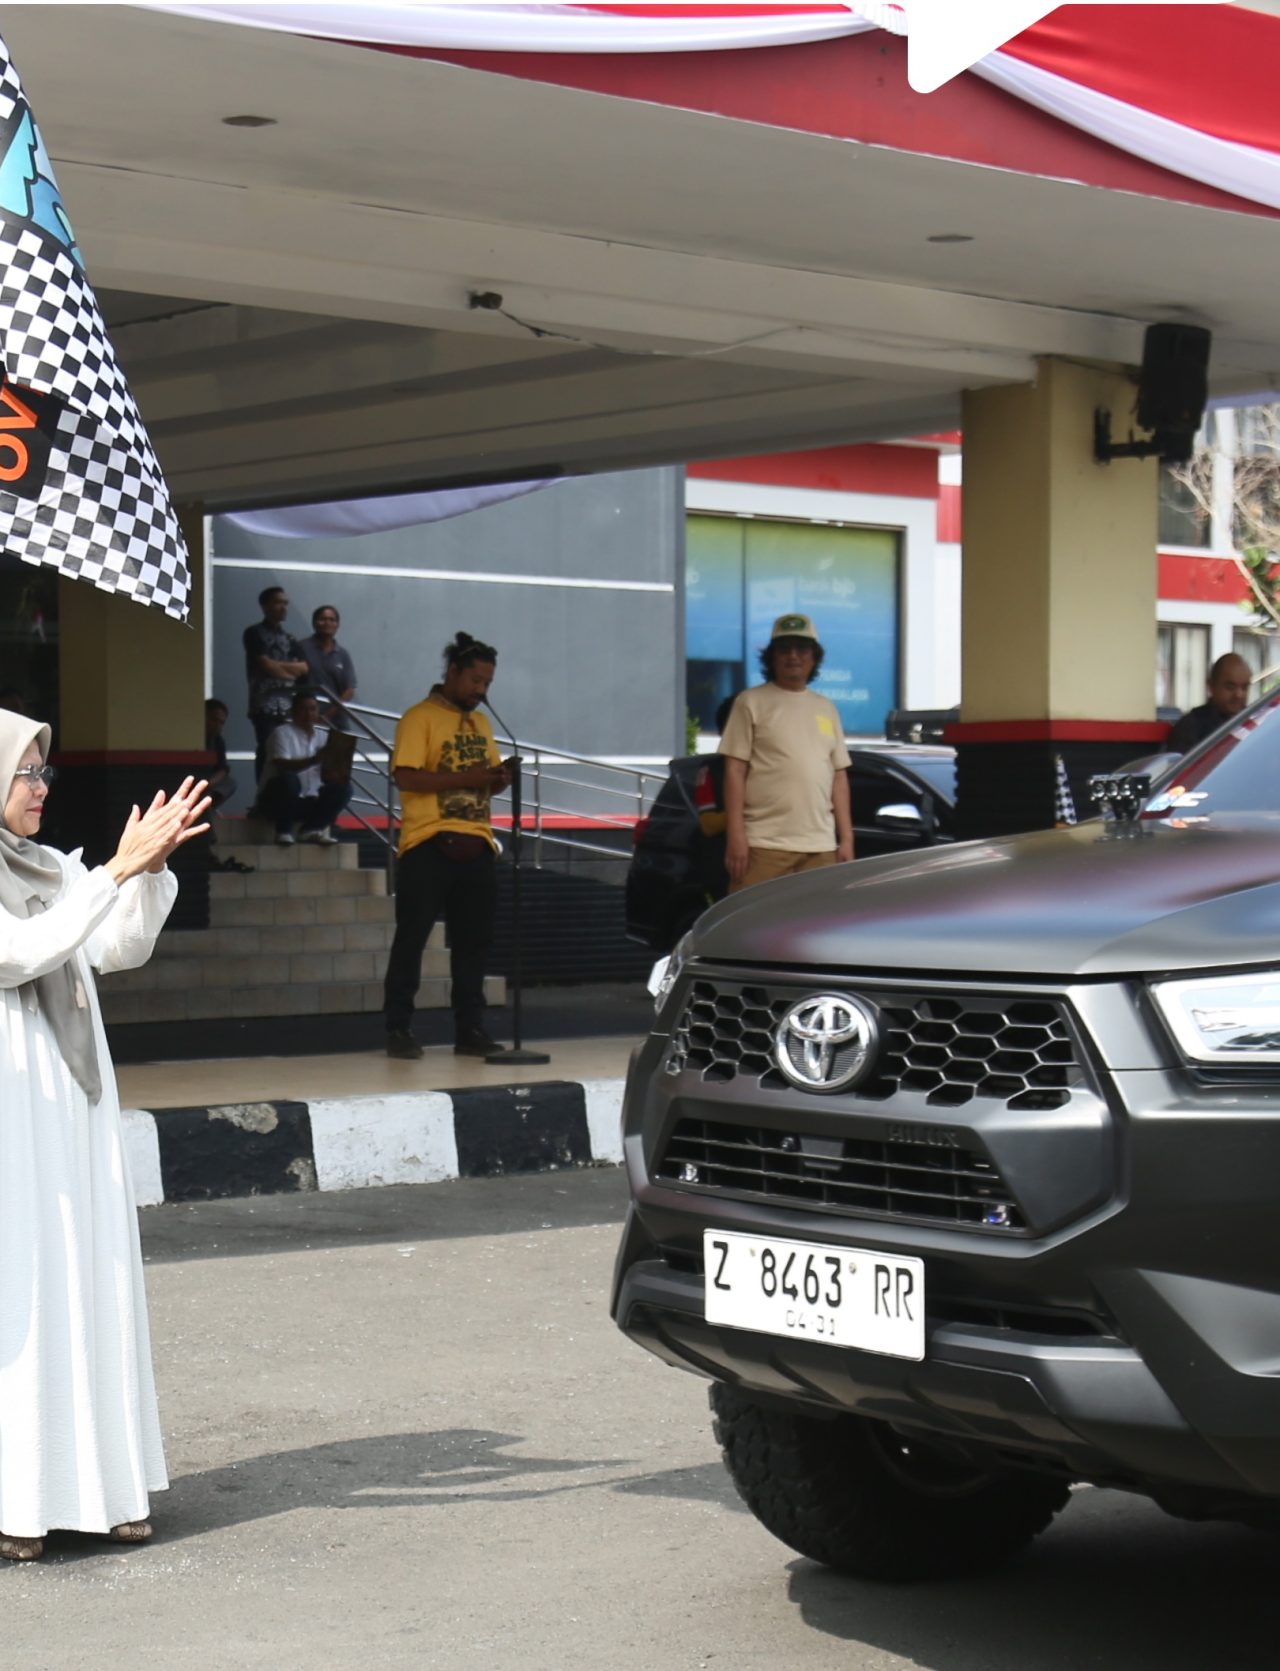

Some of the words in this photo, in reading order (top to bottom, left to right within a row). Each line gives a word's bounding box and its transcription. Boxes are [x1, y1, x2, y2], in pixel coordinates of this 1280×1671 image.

[712, 1241, 732, 1291] Z
[760, 1247, 843, 1308] 8463
[874, 1263, 915, 1321] RR
